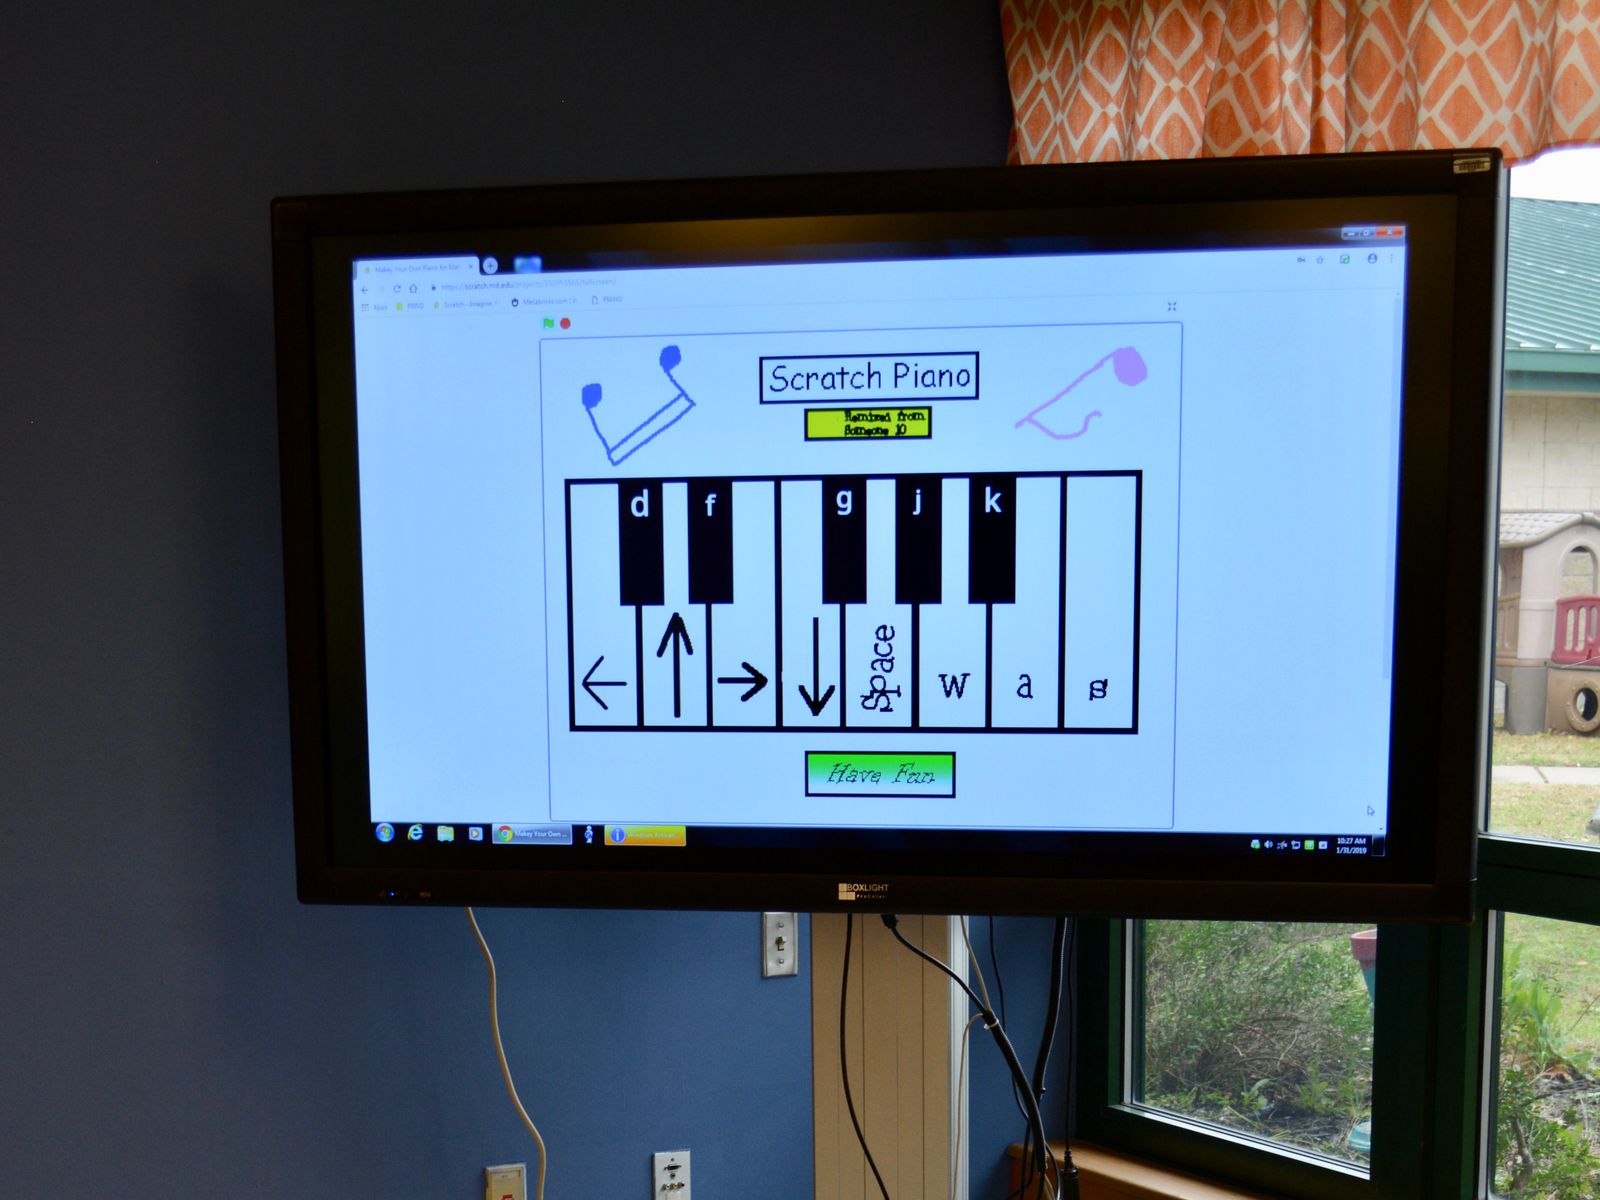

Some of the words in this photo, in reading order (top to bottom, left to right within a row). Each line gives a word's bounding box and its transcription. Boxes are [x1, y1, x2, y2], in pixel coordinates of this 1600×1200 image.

[769, 361, 882, 393] Scratch
[893, 361, 971, 389] Piano
[630, 488, 649, 518] d
[704, 493, 717, 517] f
[835, 489, 853, 516] g
[912, 488, 922, 516] j
[984, 486, 1002, 514] k
[1016, 673, 1034, 699] a
[826, 762, 882, 785] Have
[1354, 837, 1366, 845] AM
[848, 883, 889, 892] BOXLIGHT
